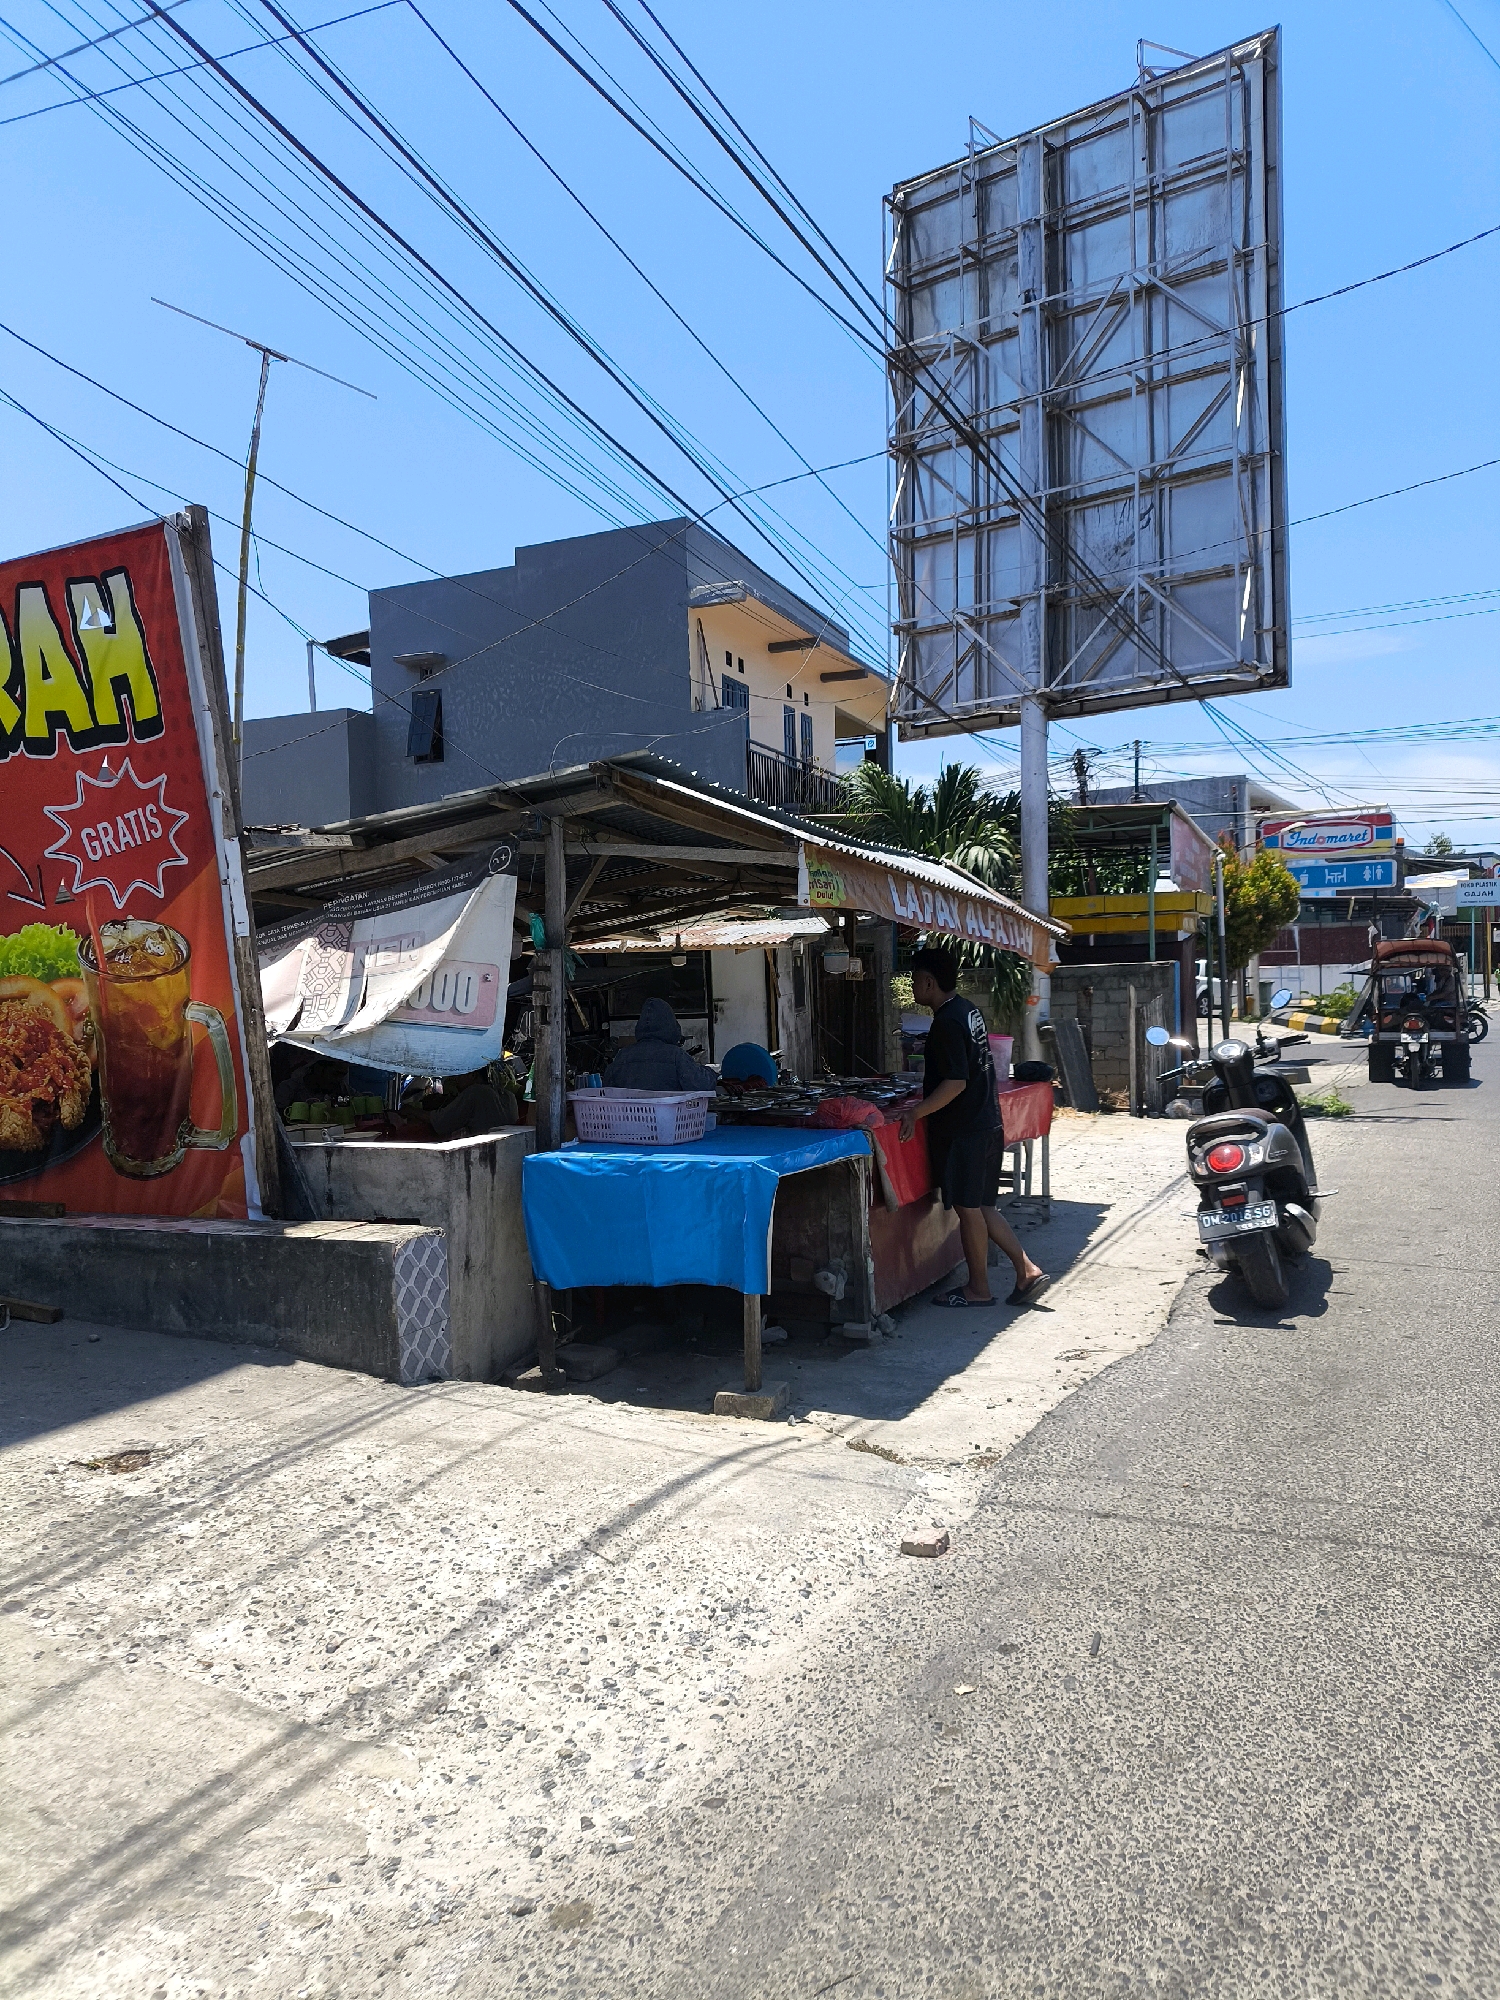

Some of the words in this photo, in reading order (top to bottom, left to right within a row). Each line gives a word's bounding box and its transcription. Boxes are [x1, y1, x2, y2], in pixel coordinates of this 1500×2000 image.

[81, 803, 163, 862] GRATIS
[1286, 829, 1369, 847] Indomaret
[1475, 881, 1498, 889] PLASTIK
[816, 890, 834, 901] Dulu!
[1463, 890, 1494, 898] GAJAH
[887, 872, 962, 932] LAPAK
